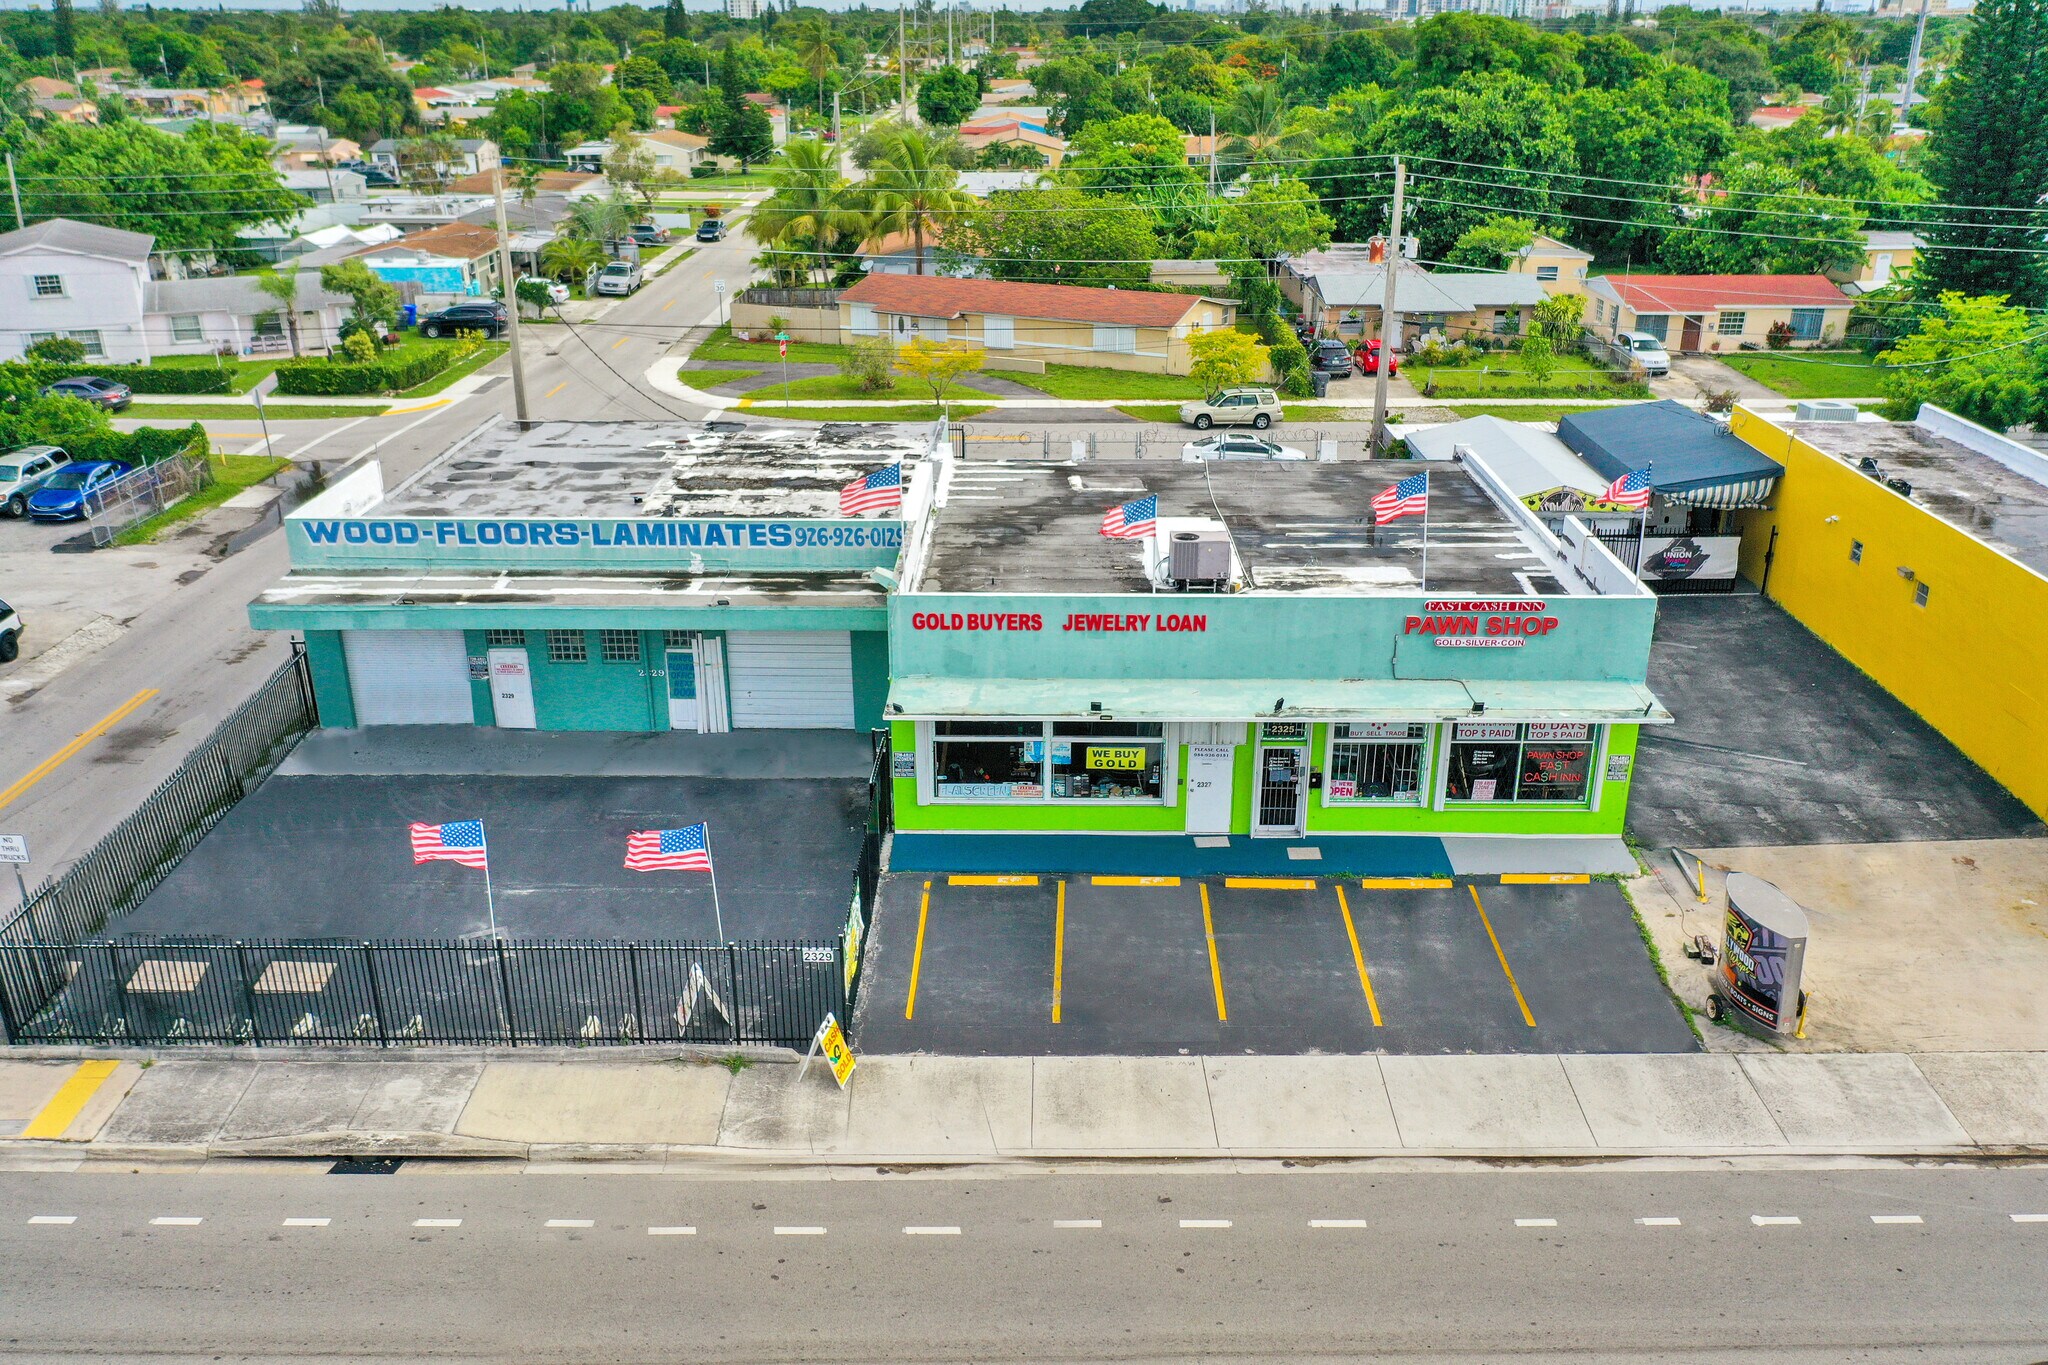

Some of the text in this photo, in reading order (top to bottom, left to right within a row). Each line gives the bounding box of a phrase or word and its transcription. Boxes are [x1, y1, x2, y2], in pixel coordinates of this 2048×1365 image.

[302, 521, 792, 547] WOOD-FLOORS-LAMINATES
[1663, 551, 1692, 559] UNION
[1428, 601, 1466, 611] FAST
[1515, 602, 1544, 611] INN
[912, 613, 1207, 632] GOLD BUYERS JEWELRY LOAN
[1405, 616, 1559, 636] PAWN SHOP
[638, 669, 665, 677] 229
[1271, 725, 1296, 734] 2325
[1459, 729, 1515, 738] TOP $ PAID!
[1552, 731, 1558, 739] $
[1560, 731, 1586, 739] PAID!
[1092, 750, 1140, 758] WE BUY
[1527, 751, 1585, 760] PAWN SHOP
[1094, 759, 1137, 768] GOLD
[1540, 761, 1570, 771] FA$T
[1525, 771, 1582, 782] CA$H INN
[804, 952, 833, 962] 2329
[1730, 987, 1748, 1006] BOATS
[1752, 1004, 1774, 1021] SIGNS
[824, 1026, 841, 1053] CASH
[836, 1052, 852, 1080] GOLD
